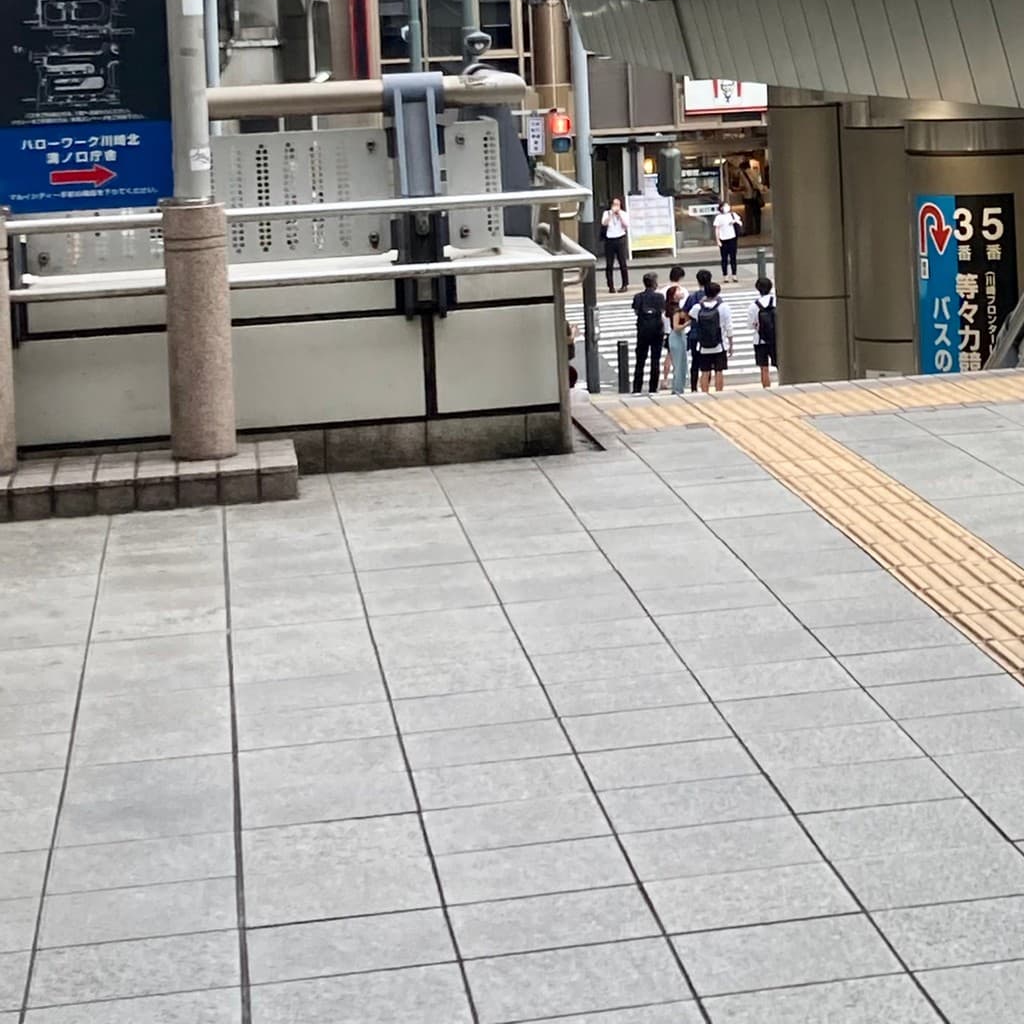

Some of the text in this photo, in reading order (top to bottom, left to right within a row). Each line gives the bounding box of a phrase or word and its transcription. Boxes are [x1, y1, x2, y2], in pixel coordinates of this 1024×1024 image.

[21, 133, 141, 150] ハローワーク川崎北
[953, 207, 974, 262] 3番
[981, 207, 1004, 261] 5番
[933, 296, 953, 372] バスの
